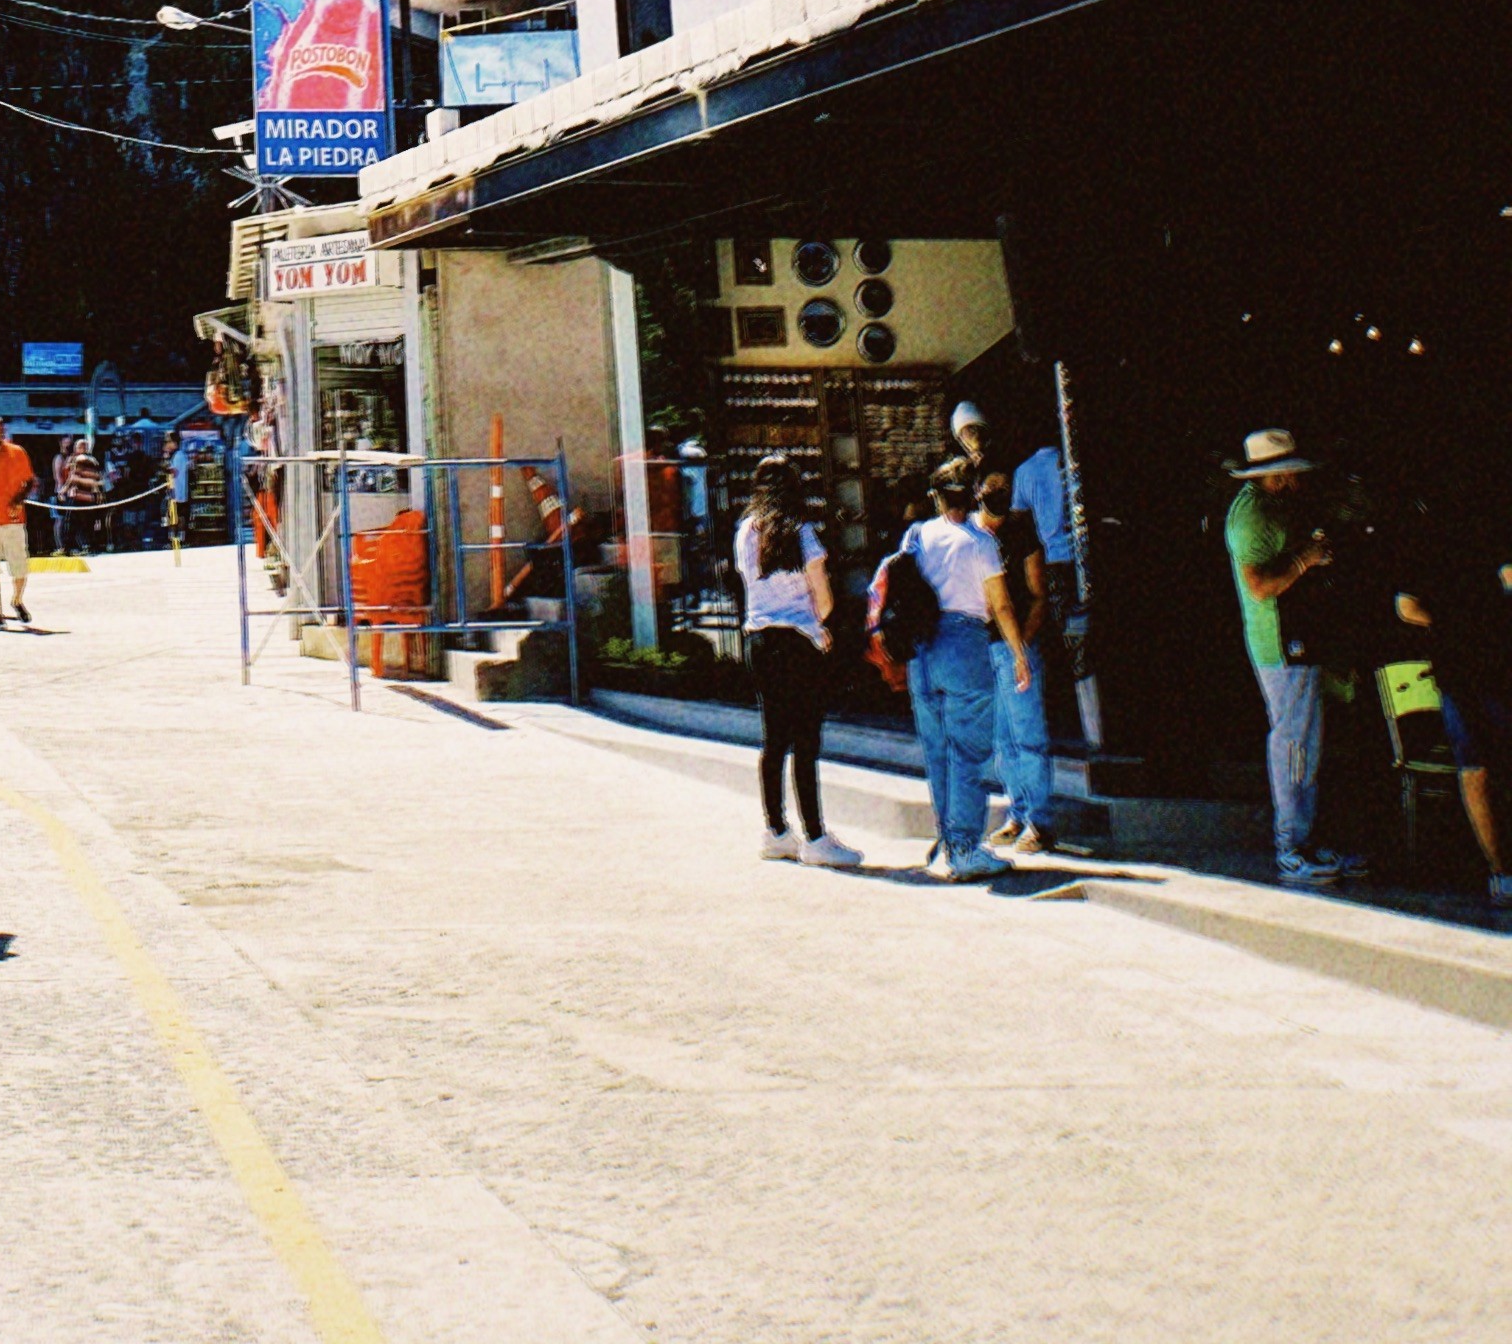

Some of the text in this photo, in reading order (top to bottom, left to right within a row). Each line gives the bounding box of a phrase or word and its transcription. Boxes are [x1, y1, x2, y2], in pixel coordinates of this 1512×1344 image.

[264, 119, 379, 140] MIRADOR
[264, 147, 380, 166] LA PIEDRA
[274, 259, 368, 291] YOM YOM
